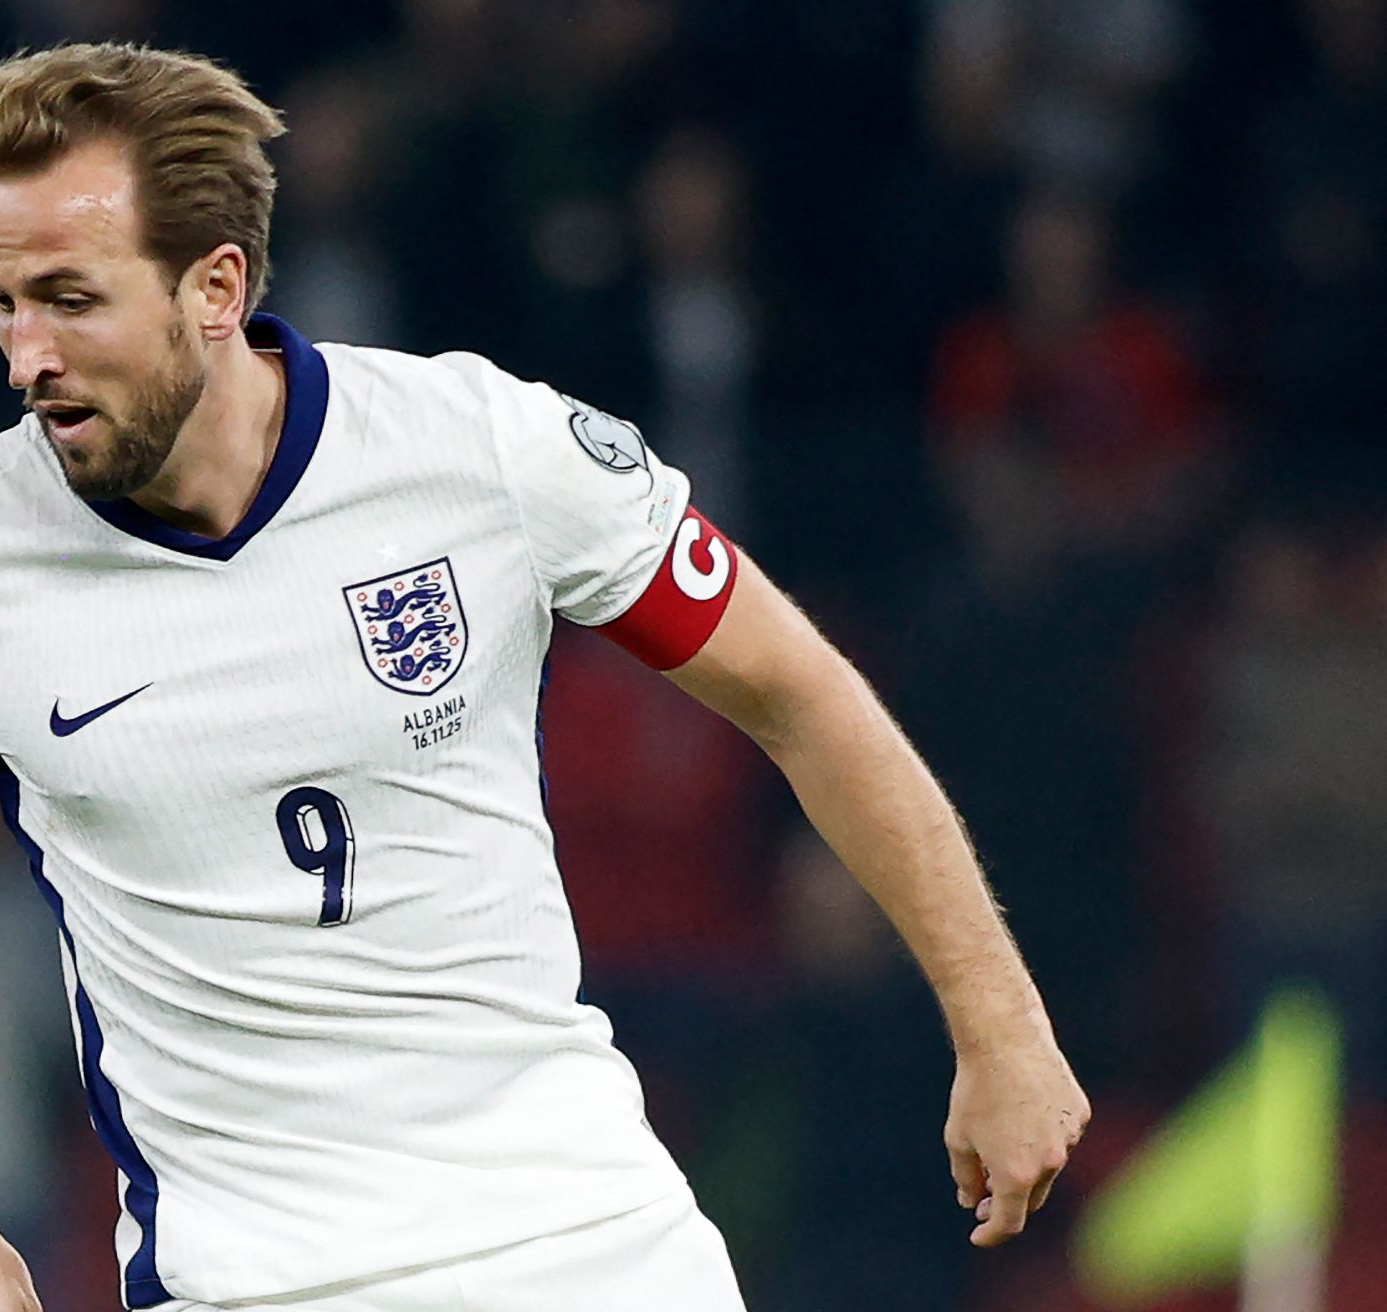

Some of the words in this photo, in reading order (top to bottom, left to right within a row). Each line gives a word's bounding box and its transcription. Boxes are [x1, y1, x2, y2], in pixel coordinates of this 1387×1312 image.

[671, 516, 730, 601] C
[403, 694, 466, 733] ALBANIA
[275, 786, 356, 928] 9
